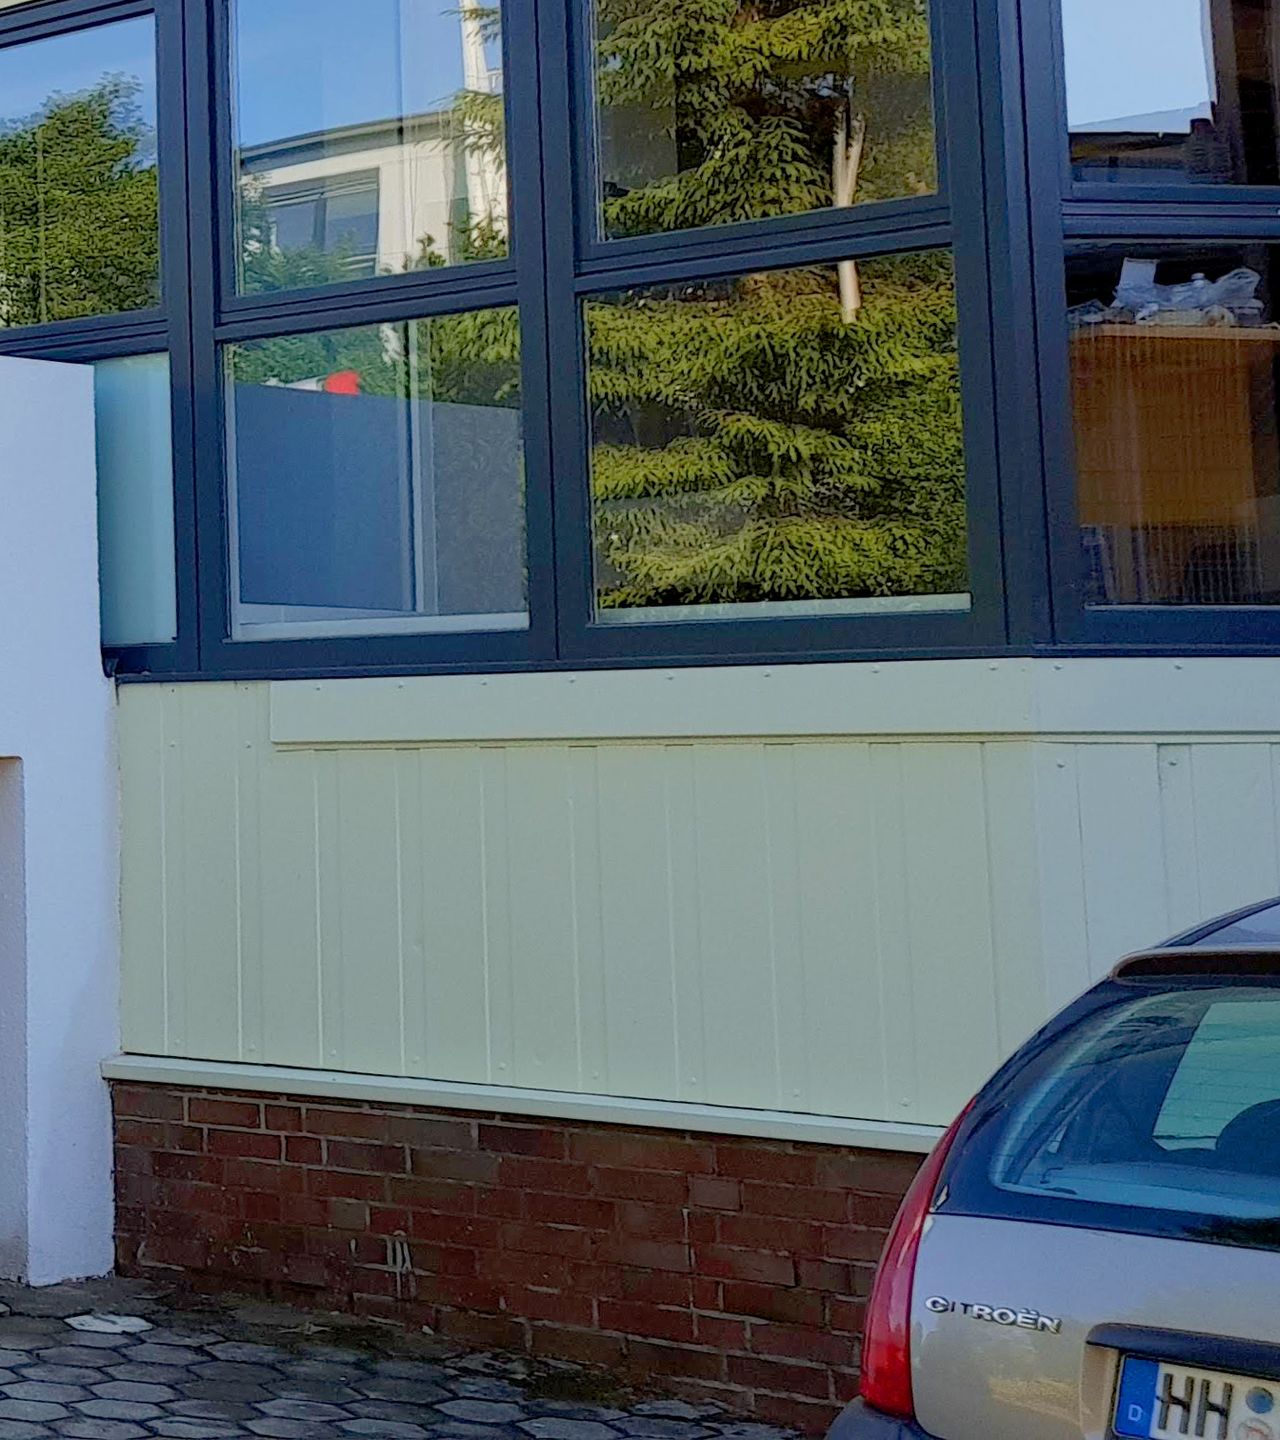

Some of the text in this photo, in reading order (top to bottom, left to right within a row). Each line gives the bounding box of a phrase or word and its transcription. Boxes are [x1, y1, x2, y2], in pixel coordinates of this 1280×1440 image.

[925, 1296, 1062, 1334] CITROËN
[1127, 1404, 1143, 1422] D
[1157, 1373, 1234, 1440] HH
